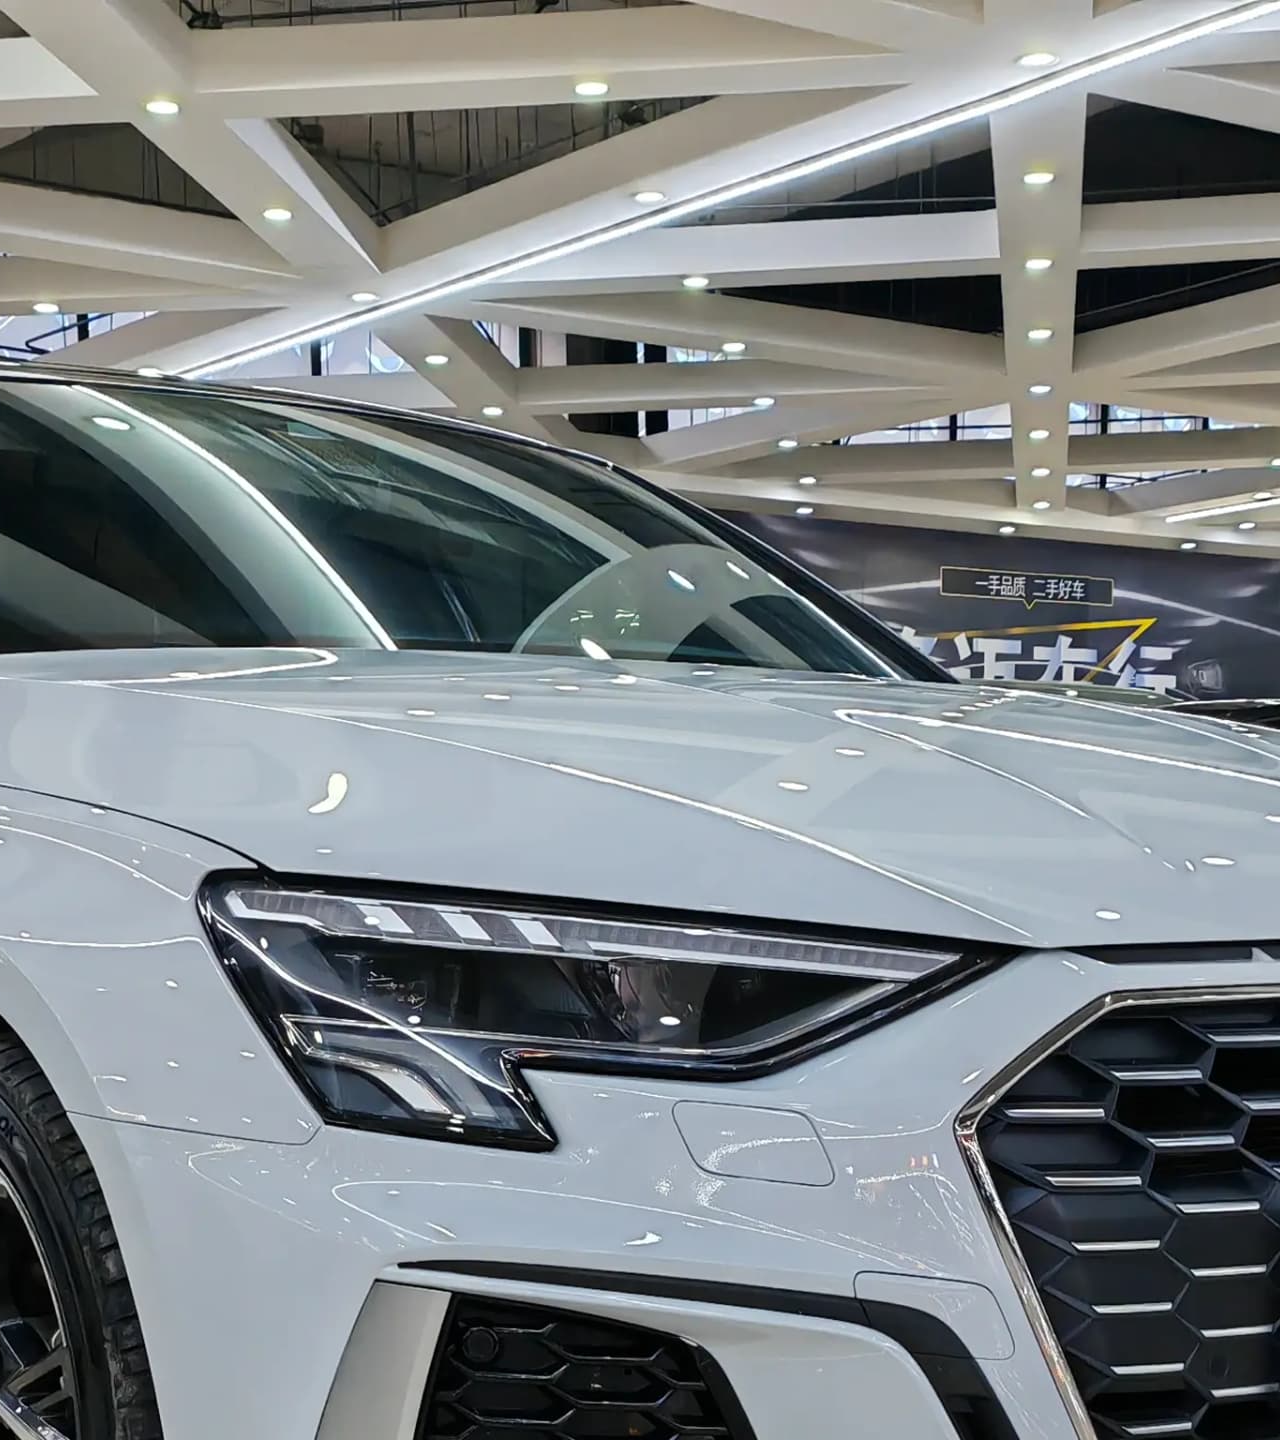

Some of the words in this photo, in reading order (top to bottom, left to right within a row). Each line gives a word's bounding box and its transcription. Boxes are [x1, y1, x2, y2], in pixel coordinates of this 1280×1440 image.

[975, 575, 1026, 597] 一手品质
[1033, 579, 1086, 600] 二手好车
